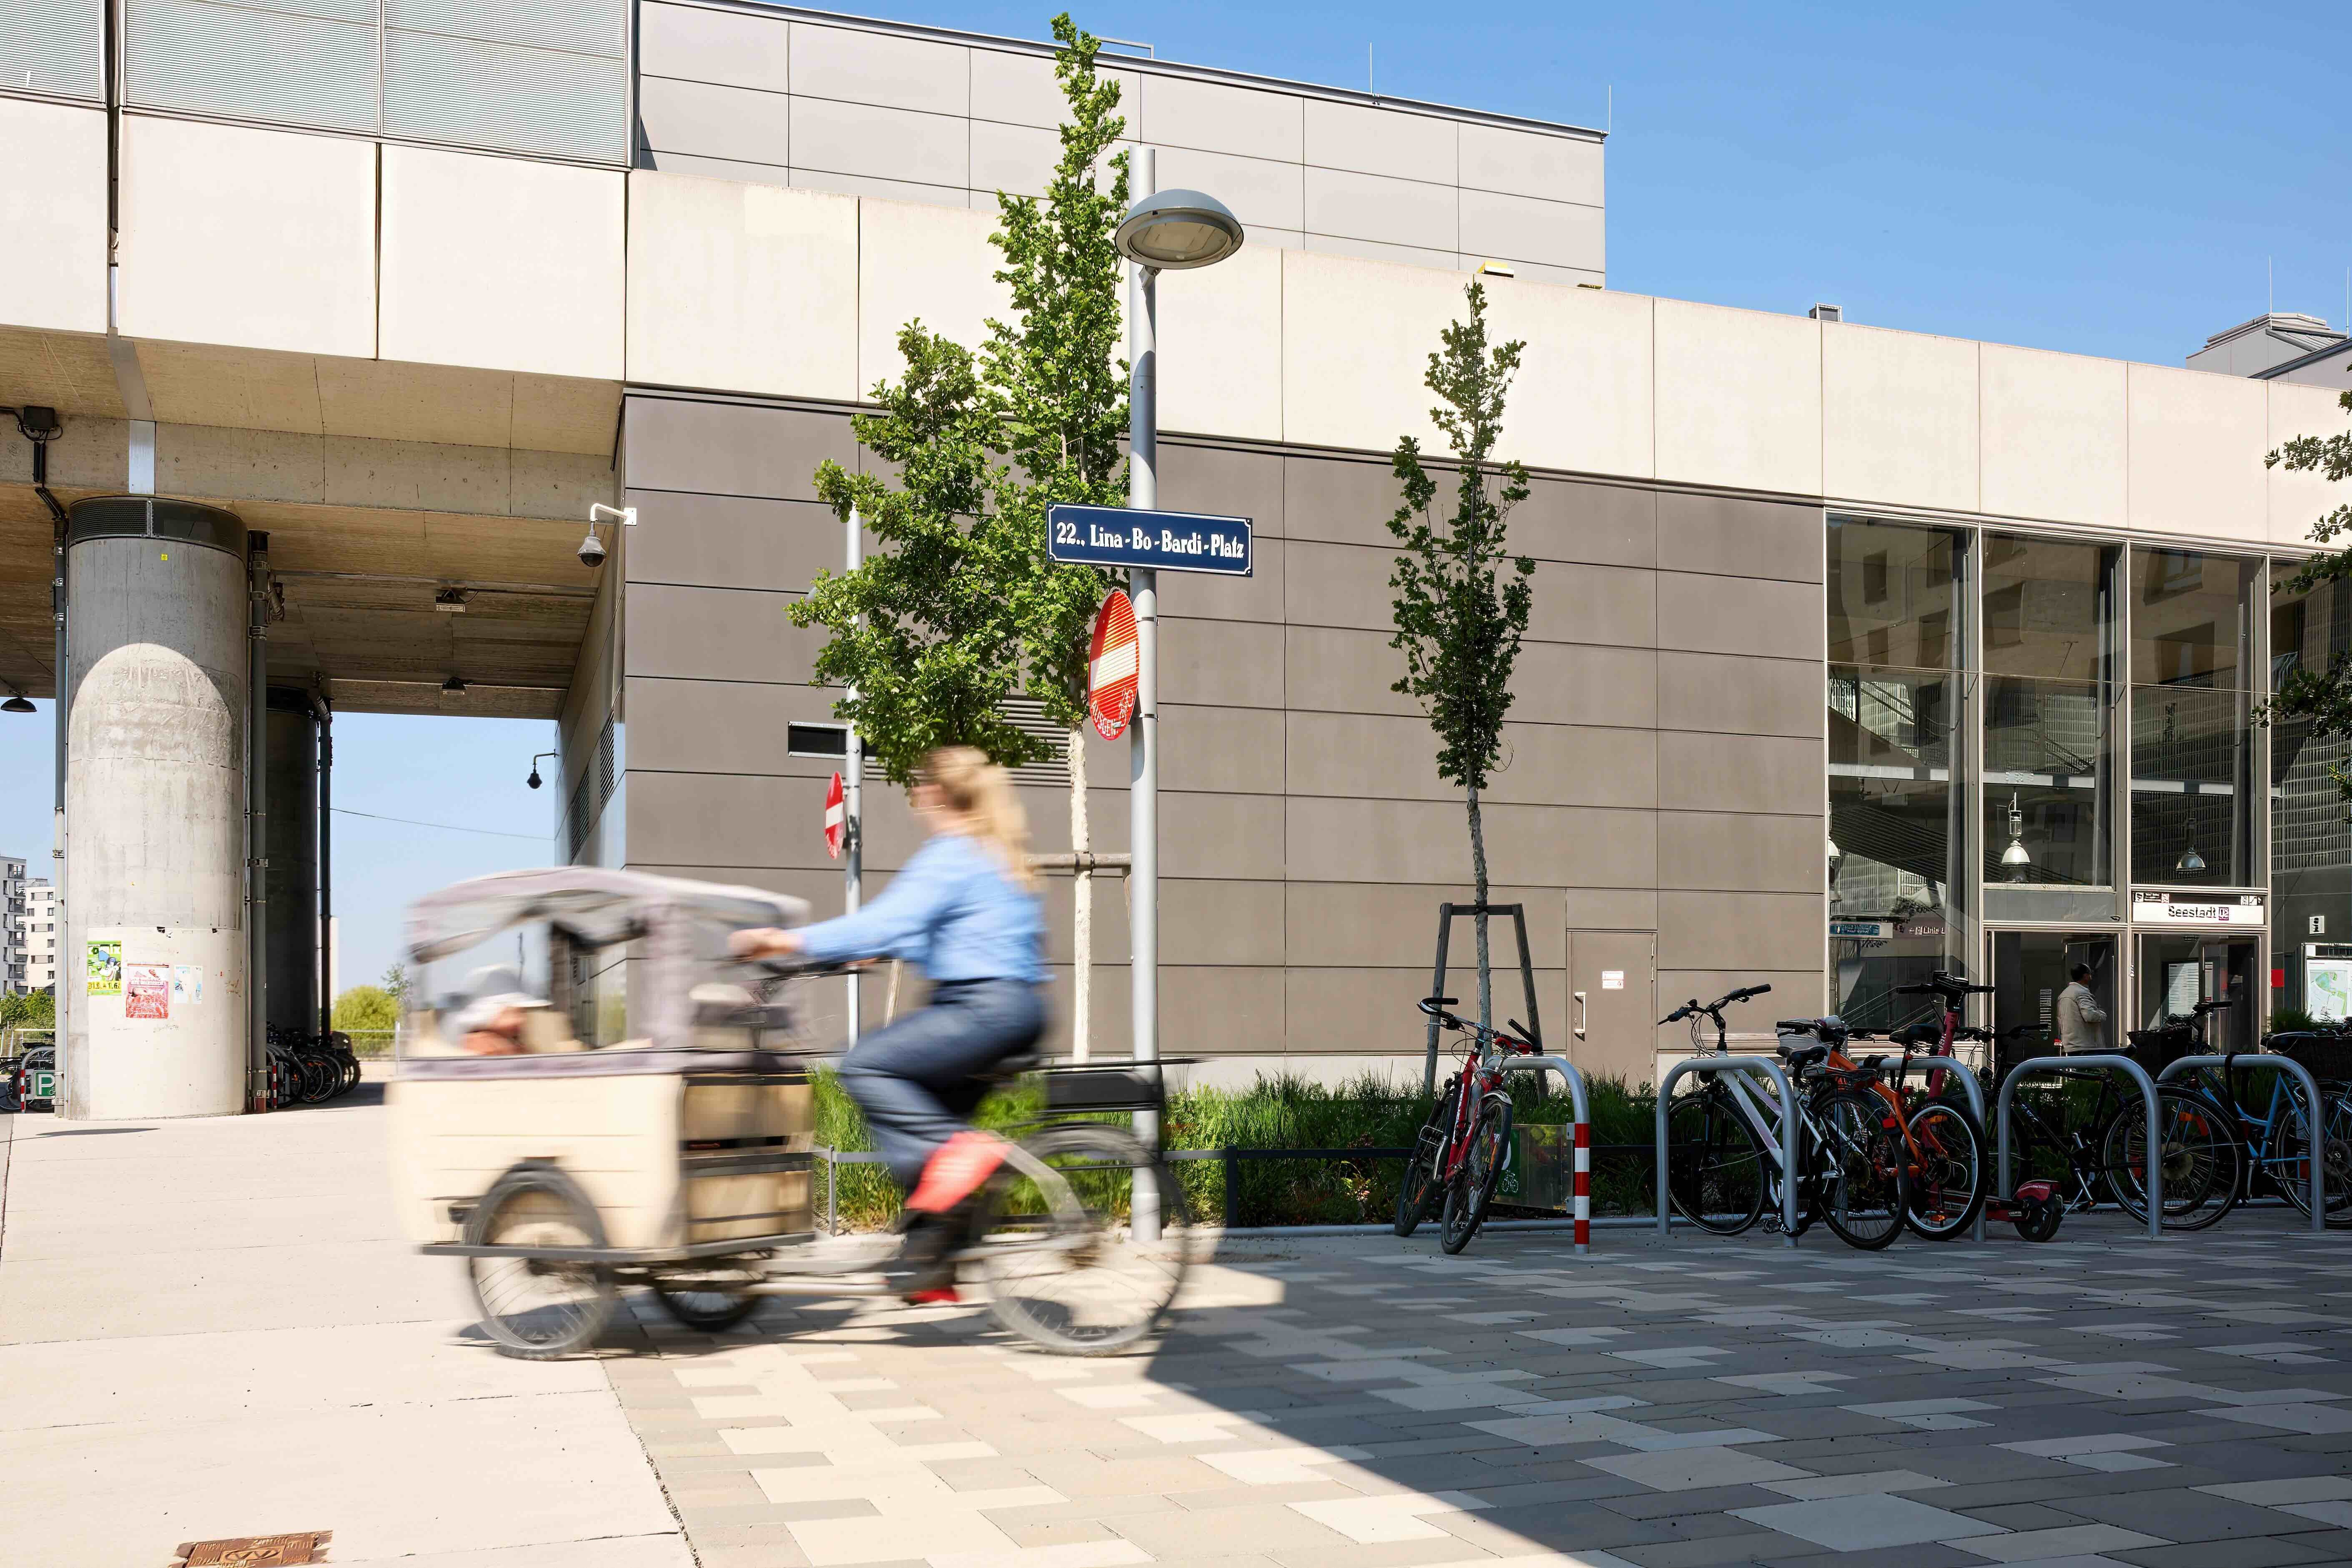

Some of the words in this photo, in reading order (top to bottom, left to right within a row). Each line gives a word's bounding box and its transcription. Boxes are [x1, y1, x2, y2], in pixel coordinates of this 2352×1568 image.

[1056, 522, 1086, 547] 22.,
[2168, 906, 2217, 918] Seestadt
[38, 1074, 55, 1095] P
